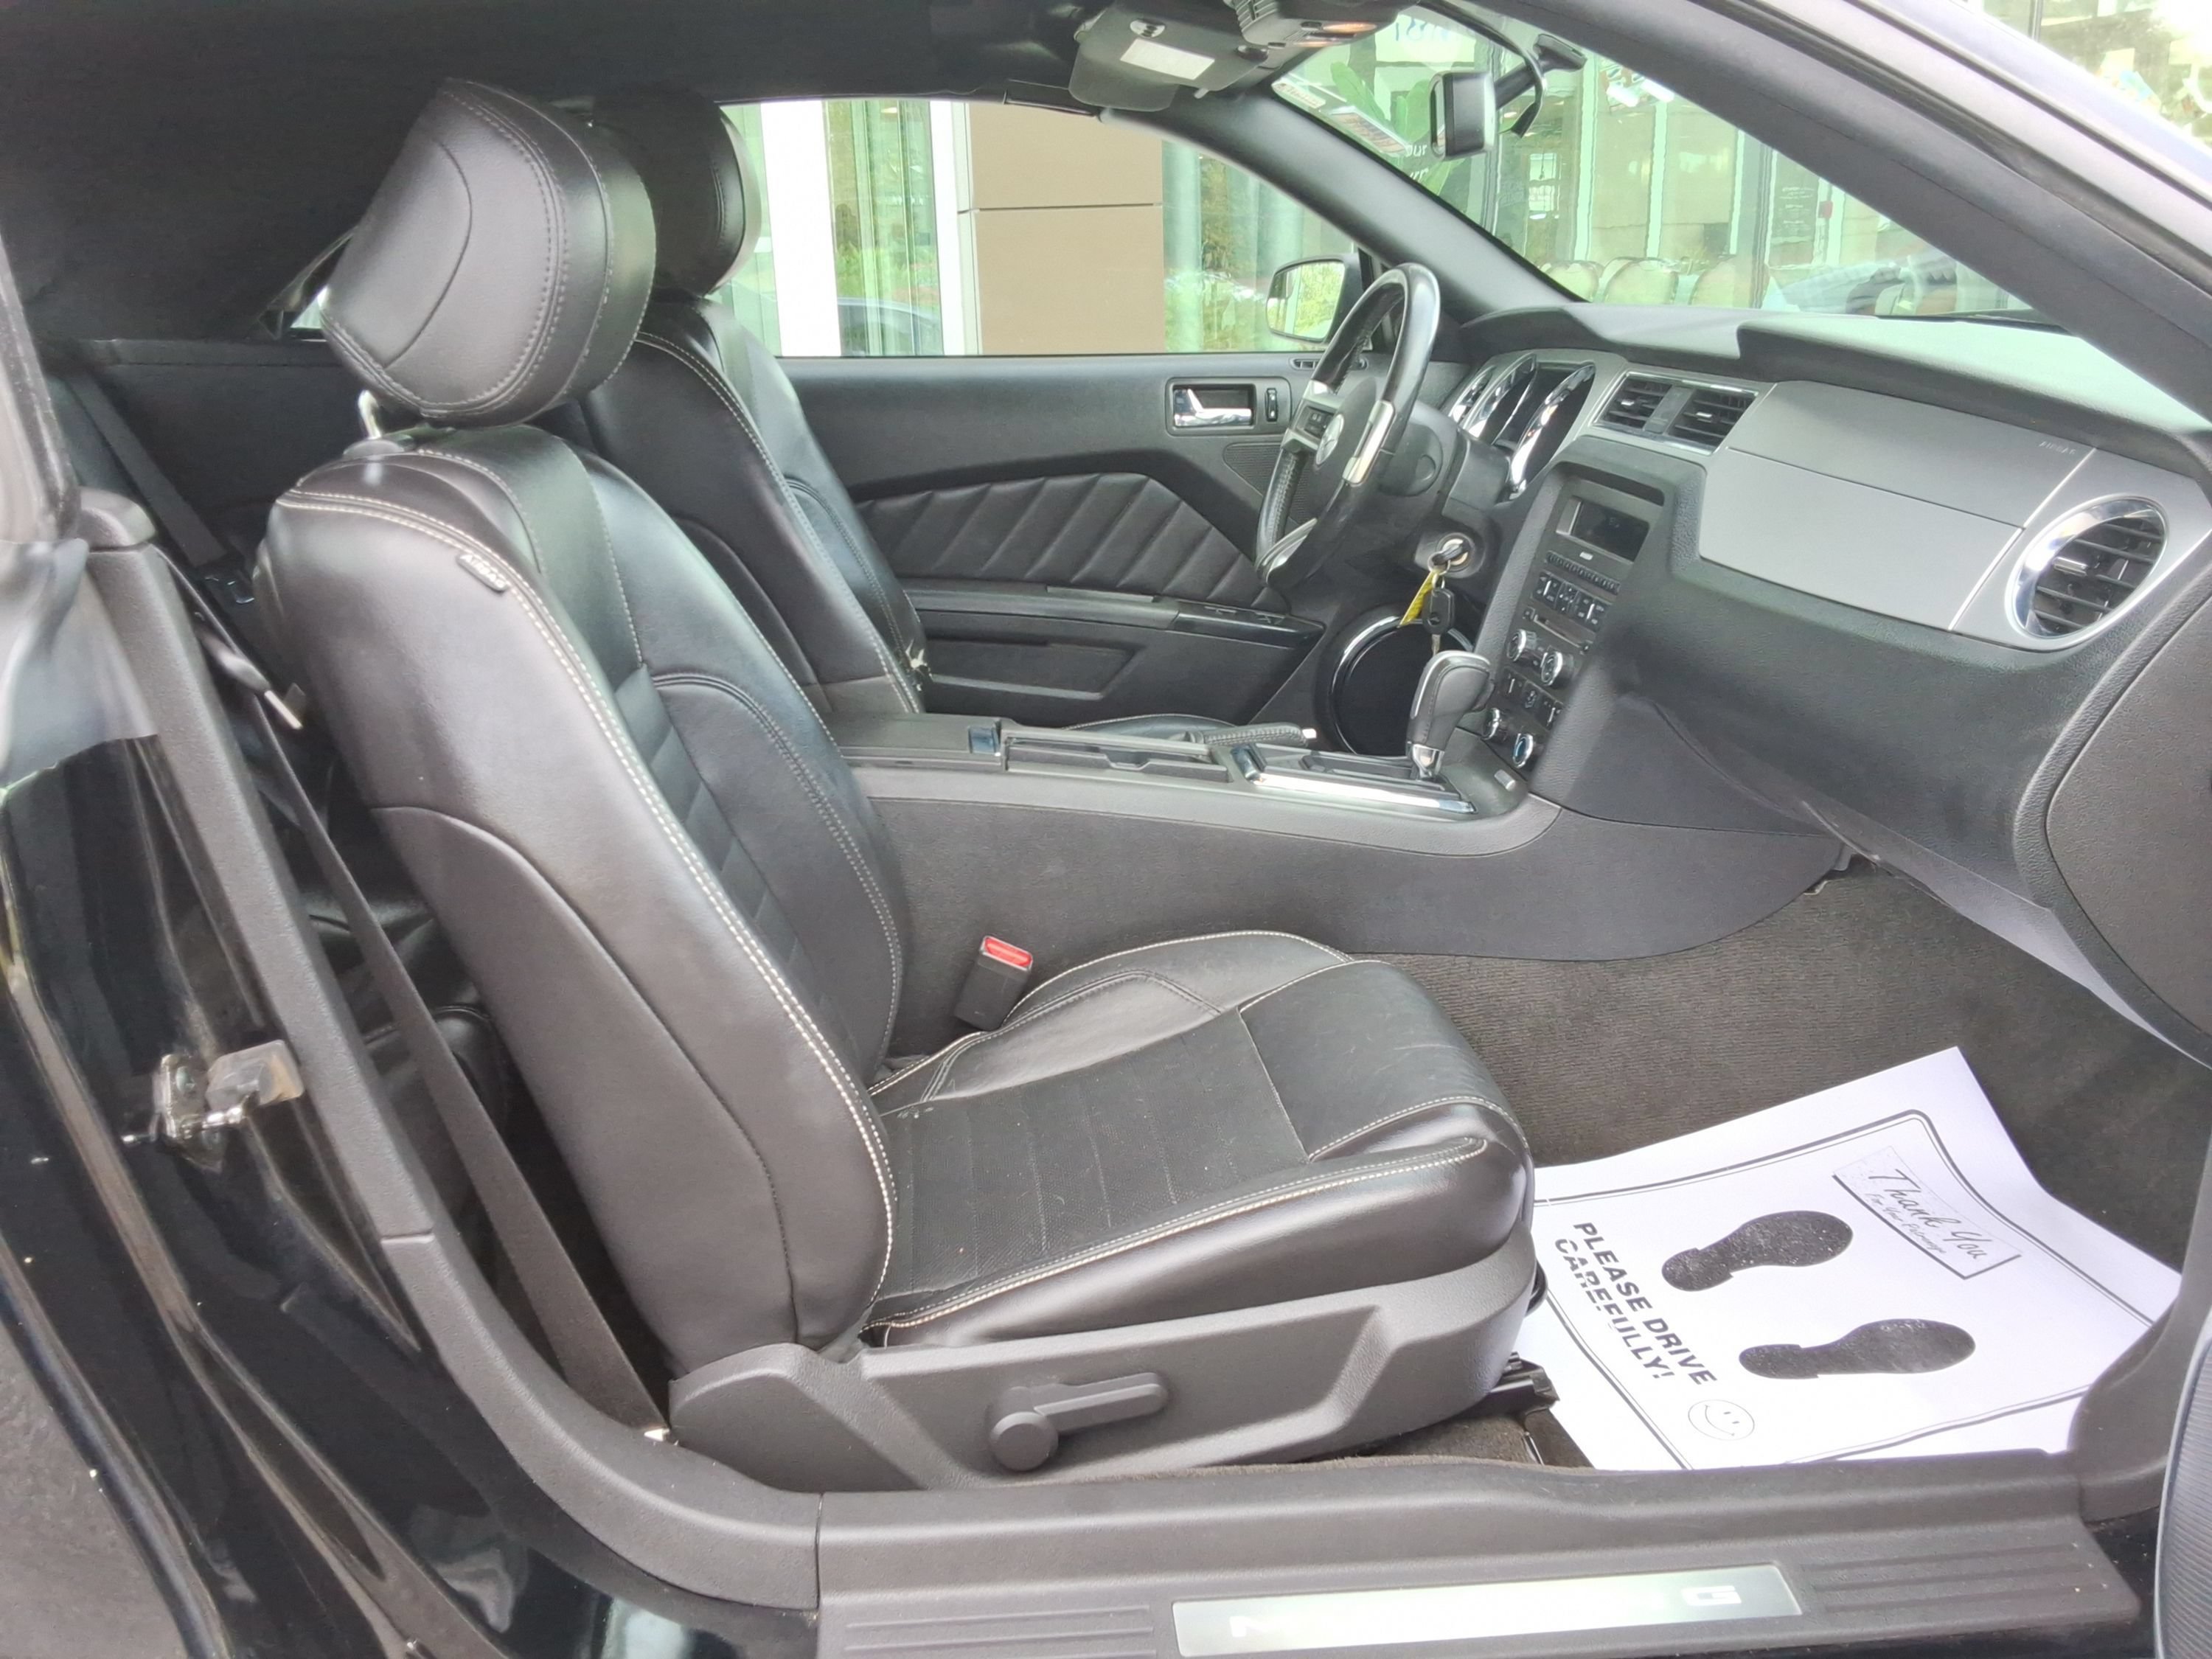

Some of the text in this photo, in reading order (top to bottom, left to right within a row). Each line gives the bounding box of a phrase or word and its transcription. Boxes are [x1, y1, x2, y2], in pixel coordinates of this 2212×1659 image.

[1868, 1169, 1993, 1260] Thank You
[1554, 1238, 1676, 1380] CAREFULLY!
[1573, 1222, 1718, 1385] PLEASE DRIVE
